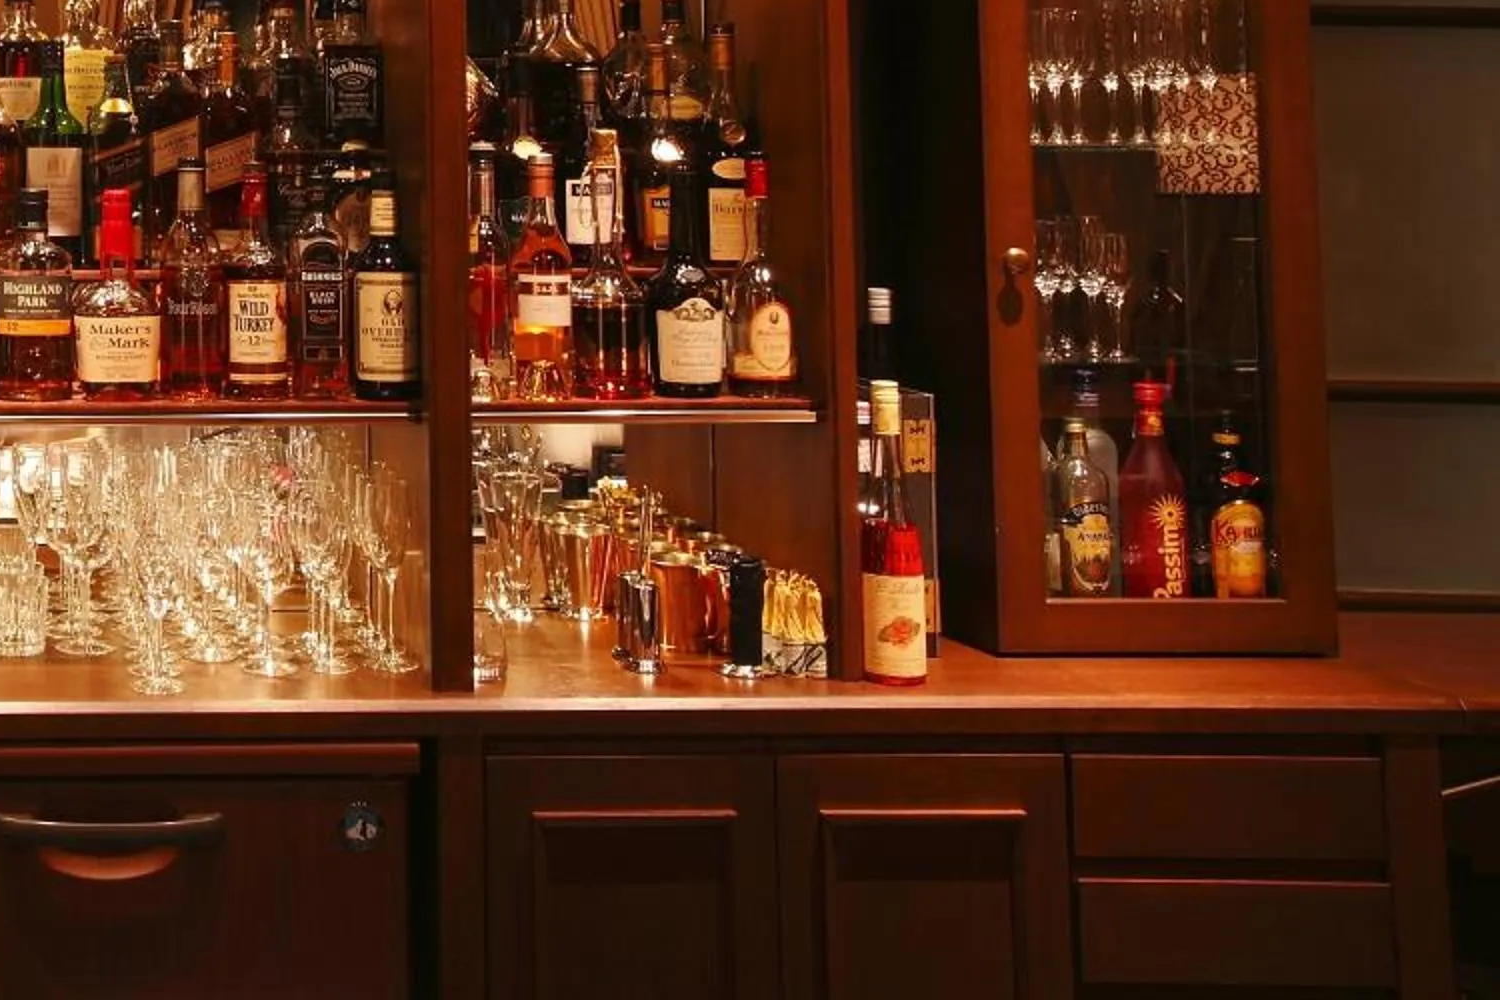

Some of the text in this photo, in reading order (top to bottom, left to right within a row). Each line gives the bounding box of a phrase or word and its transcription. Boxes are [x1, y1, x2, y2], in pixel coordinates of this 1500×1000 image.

[4, 281, 63, 296] HIGHLAND
[17, 294, 48, 307] PARK
[238, 300, 269, 317] WILD
[232, 314, 275, 332] TURKEY
[108, 337, 150, 348] Mark
